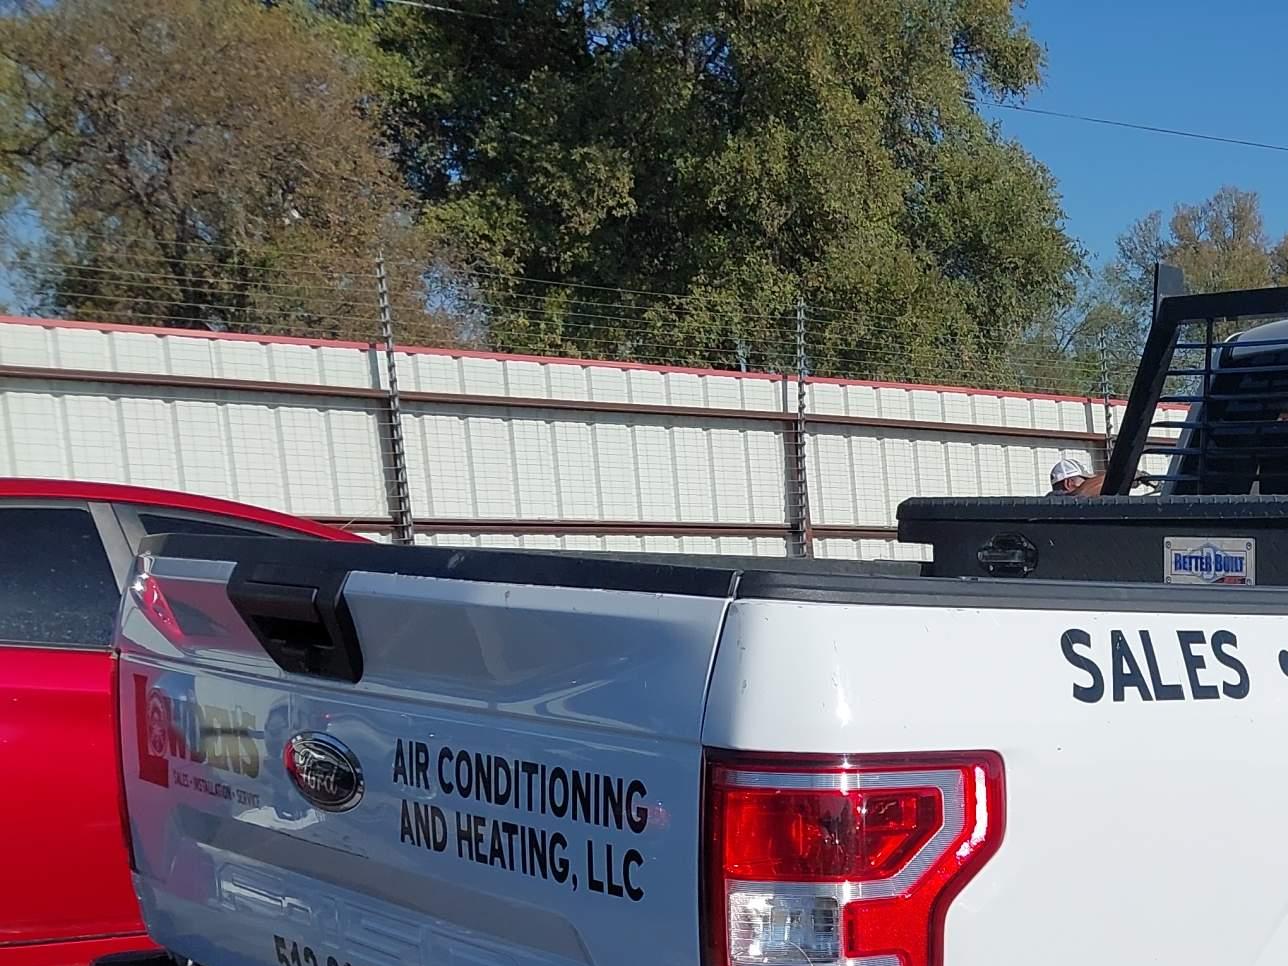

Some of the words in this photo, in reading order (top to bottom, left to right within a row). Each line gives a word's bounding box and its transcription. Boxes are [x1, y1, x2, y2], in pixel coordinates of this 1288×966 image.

[1174, 552, 1213, 572] BETTER
[1214, 553, 1245, 573] BUILT
[1060, 629, 1251, 704] SALES
[296, 747, 339, 795] Ford
[393, 738, 430, 791] AIR
[437, 746, 648, 834] CONDITIONING
[400, 798, 448, 852] AND
[455, 811, 579, 892] HEATING,
[587, 839, 645, 902] LLC
